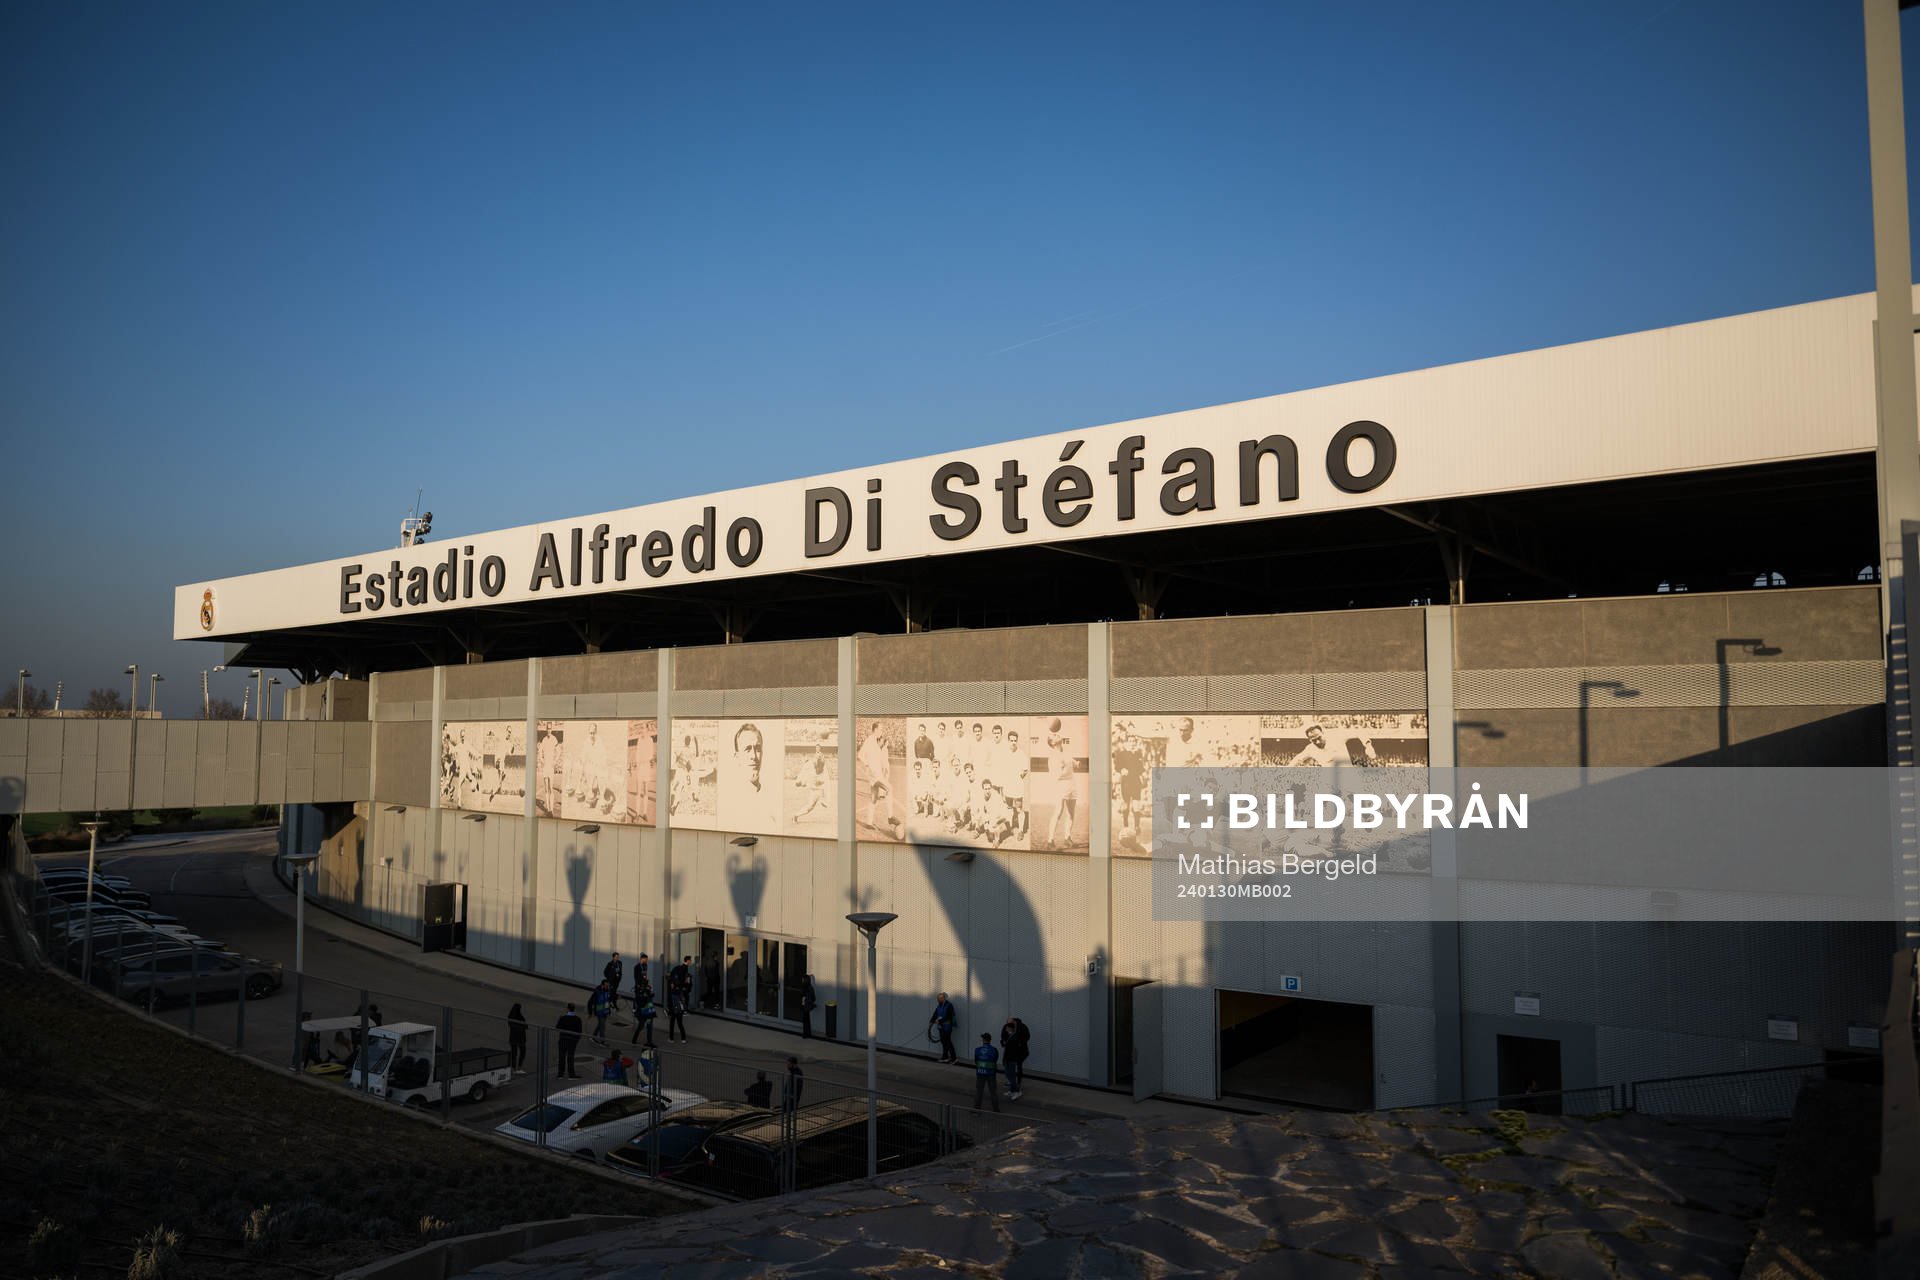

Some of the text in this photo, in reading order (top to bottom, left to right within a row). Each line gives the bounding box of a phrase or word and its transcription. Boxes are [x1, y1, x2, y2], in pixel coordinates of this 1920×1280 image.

[339, 420, 1397, 615] Estadio Alfredo Di Stéfano
[1287, 978, 1296, 989] P
